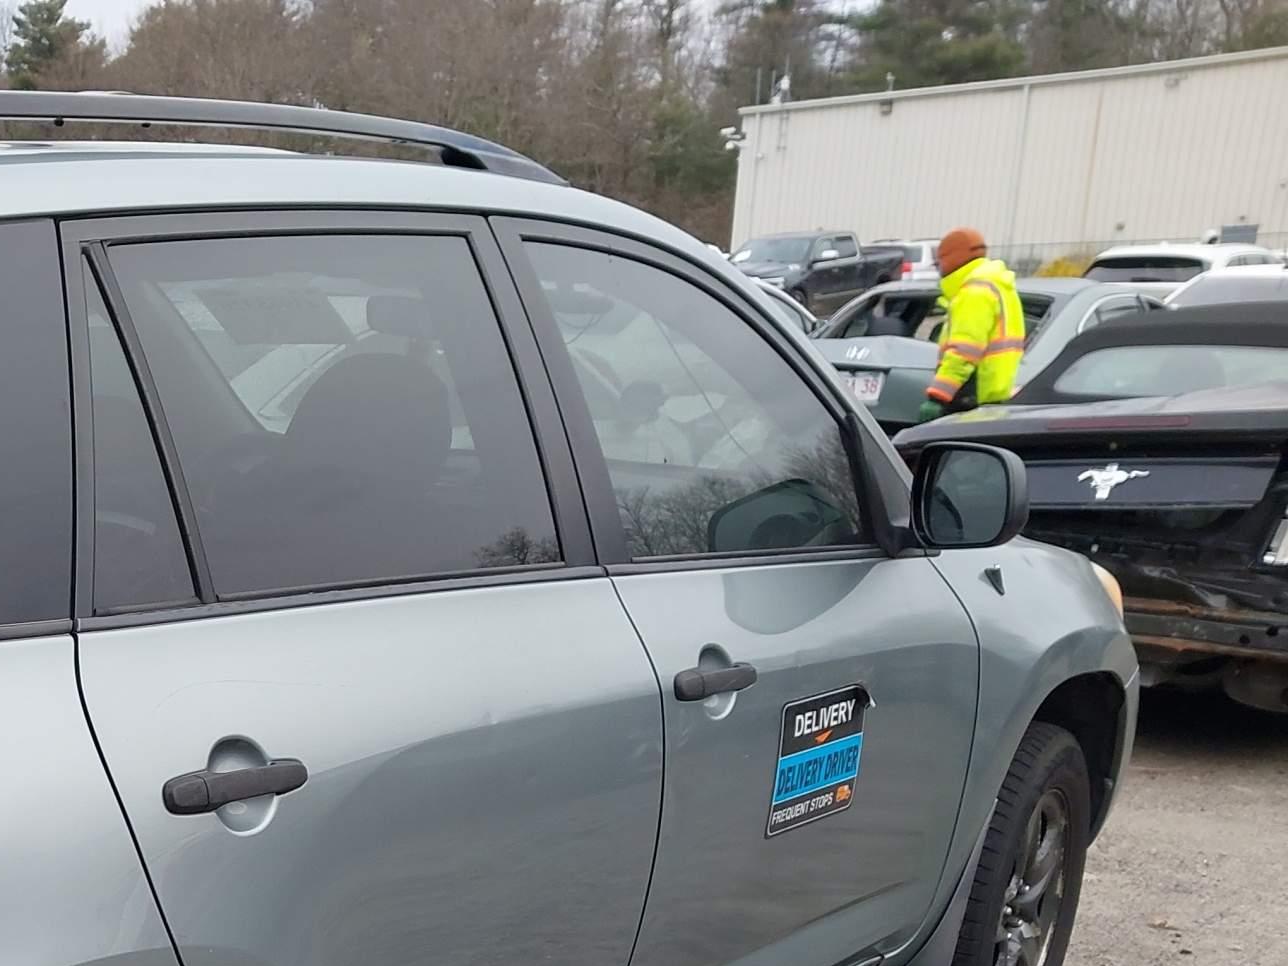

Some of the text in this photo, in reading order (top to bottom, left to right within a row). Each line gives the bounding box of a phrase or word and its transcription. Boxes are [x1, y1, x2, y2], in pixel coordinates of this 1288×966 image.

[794, 699, 856, 737] DELIVERY
[776, 746, 859, 796] DELIVERY DRIVER
[771, 792, 834, 825] FREQUENT STOPS
